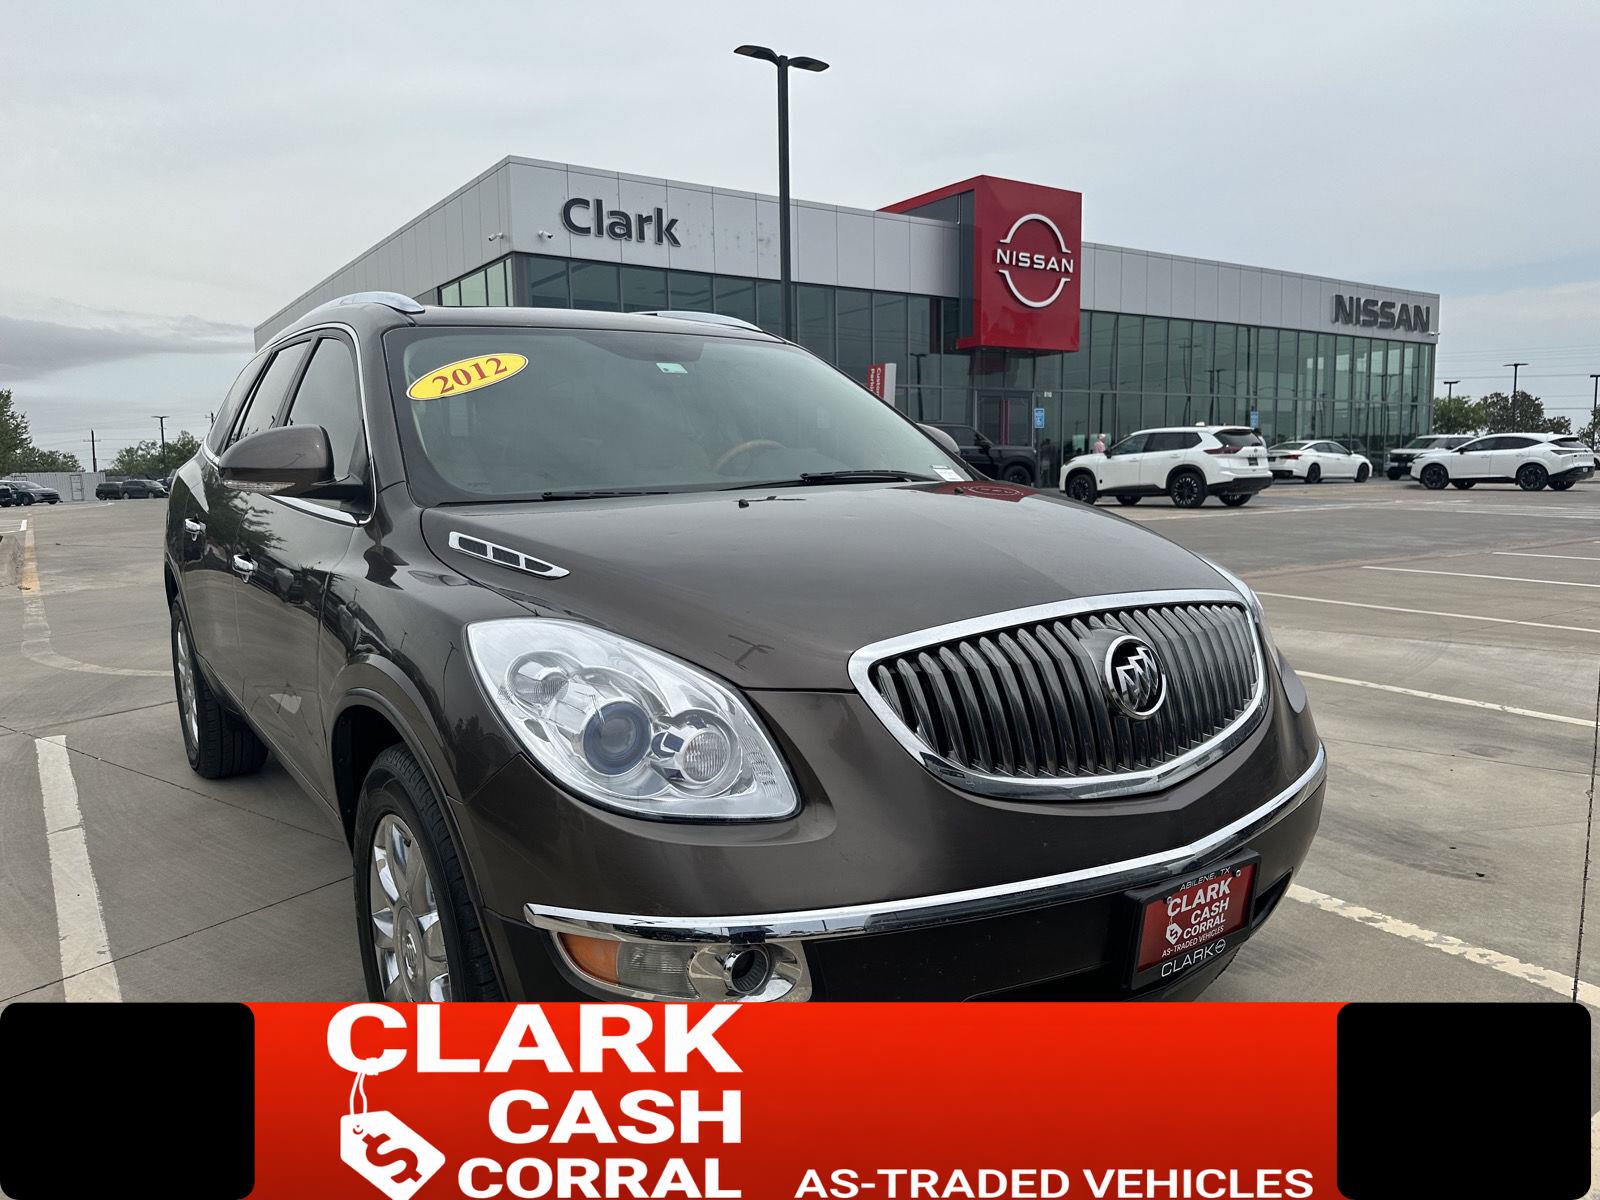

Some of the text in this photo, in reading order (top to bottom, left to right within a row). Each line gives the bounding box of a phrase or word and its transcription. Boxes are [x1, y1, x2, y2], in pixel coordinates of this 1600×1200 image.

[561, 197, 682, 247] Clark
[996, 248, 1074, 273] NISSAN
[1332, 294, 1431, 333] NISSAN
[432, 357, 507, 394] 2012
[1220, 867, 1231, 876] TX
[1167, 877, 1233, 917] CLARK
[1191, 897, 1229, 925] CASH
[1162, 938, 1198, 958] AS-TRADED
[1199, 925, 1225, 943] VEHICLES
[1183, 913, 1226, 939] CORRAL
[1161, 943, 1215, 977] CLARK
